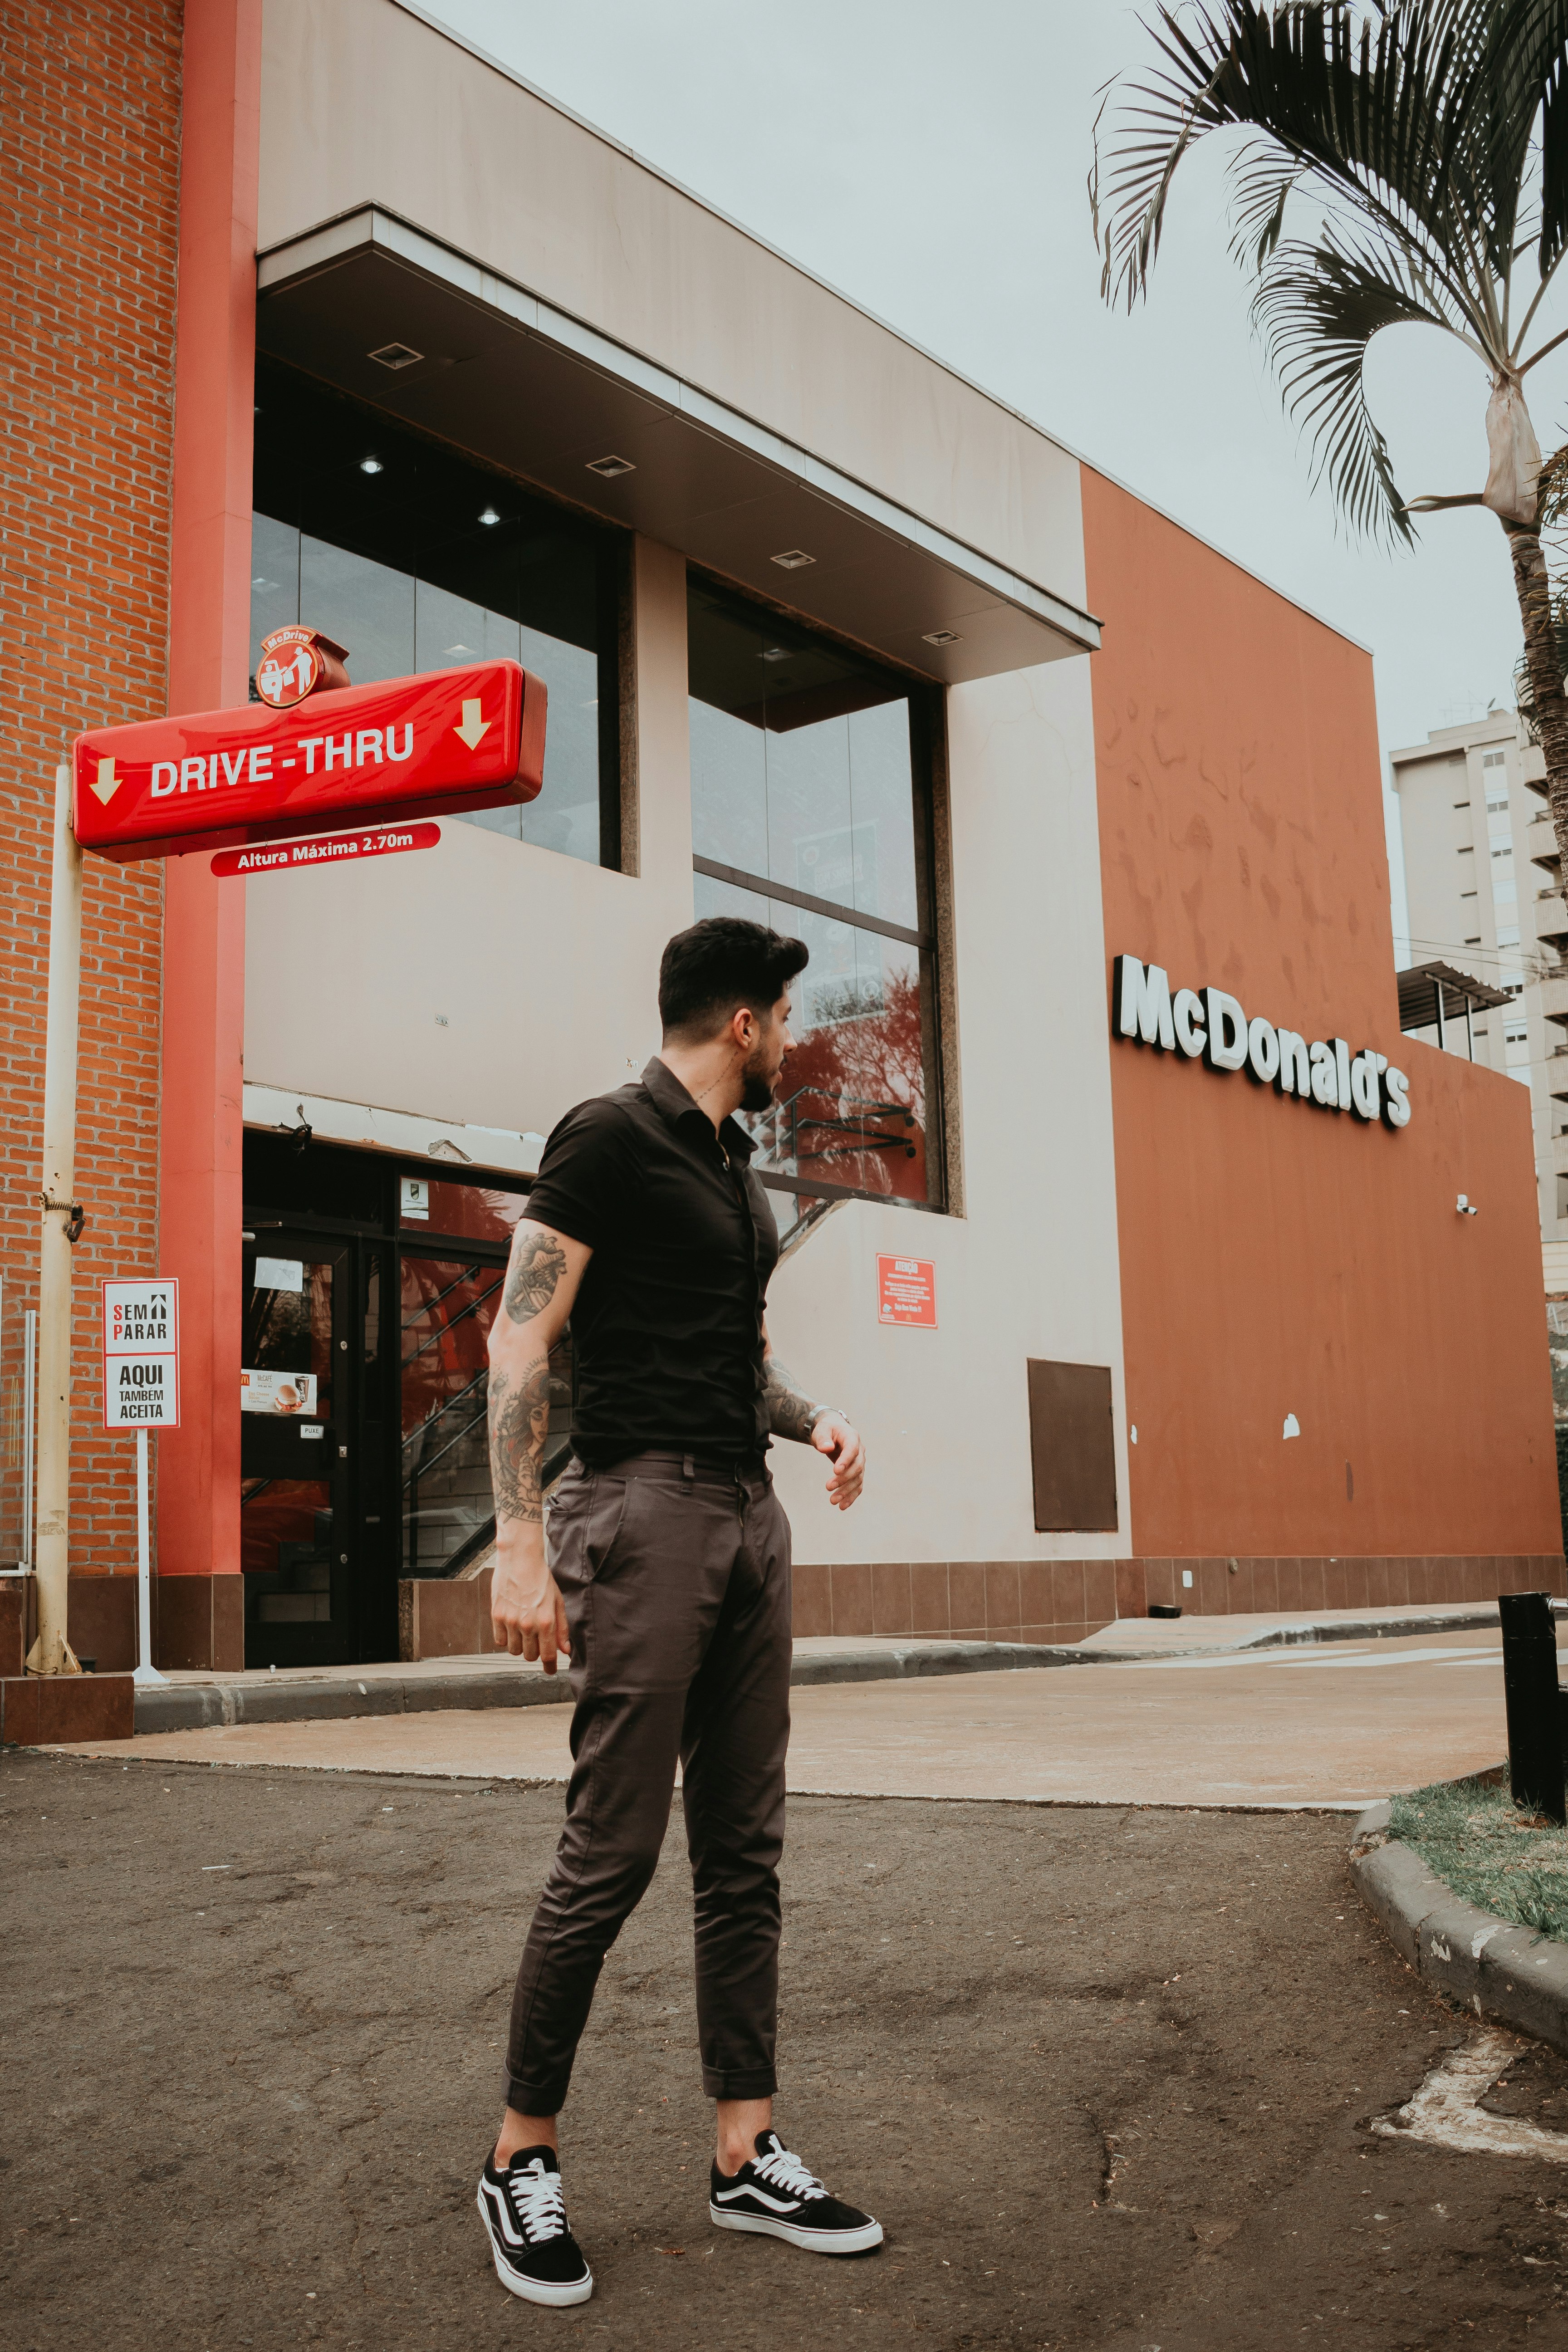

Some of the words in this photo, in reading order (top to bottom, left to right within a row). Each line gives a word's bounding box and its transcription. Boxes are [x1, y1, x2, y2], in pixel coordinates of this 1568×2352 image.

[267, 630, 309, 649] McDrive
[238, 851, 288, 868] Altura
[292, 841, 358, 861] Máxima
[363, 833, 412, 851] 2.70m
[1115, 954, 1411, 1128] McDonald's
[113, 1304, 147, 1321] SEM
[113, 1323, 167, 1340] PARAR
[119, 1364, 163, 1388] AQUI
[119, 1387, 164, 1402] TAMBÉM
[120, 1404, 163, 1419] ACEITA
